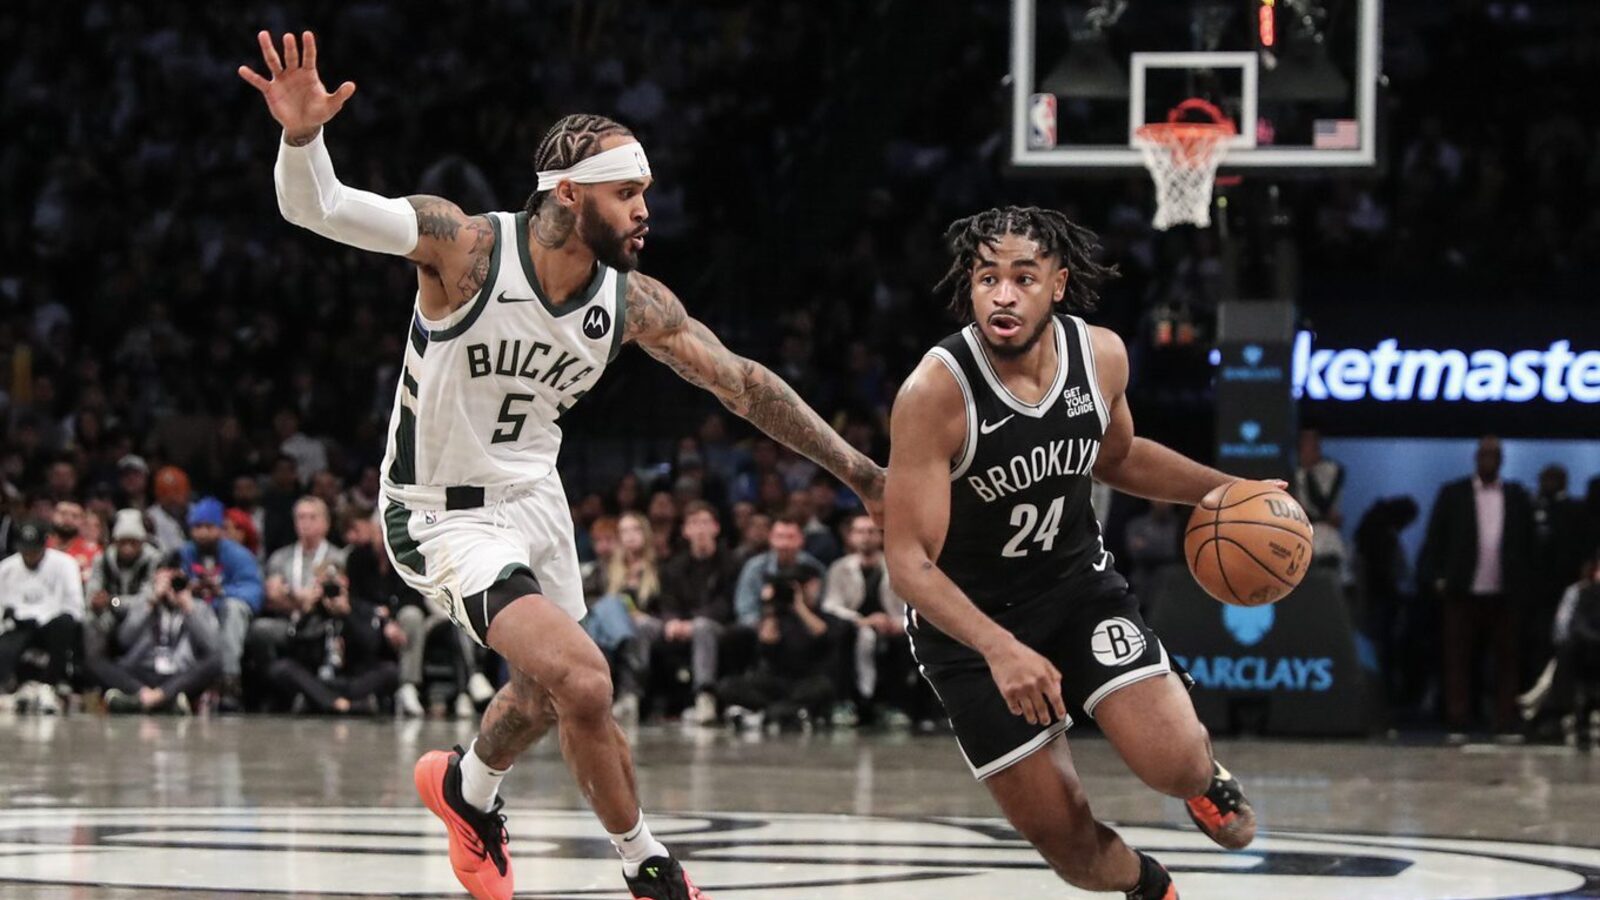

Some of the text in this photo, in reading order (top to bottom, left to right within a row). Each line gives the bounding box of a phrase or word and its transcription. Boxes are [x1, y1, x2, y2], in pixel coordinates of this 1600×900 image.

[467, 339, 594, 392] BUCKS
[1291, 330, 1600, 402] ketmaste
[1063, 386, 1080, 399] GET
[1065, 393, 1091, 409] YOUR
[1067, 401, 1094, 418] GUIDE
[491, 393, 535, 444] 5
[1001, 496, 1065, 558] 24
[1106, 624, 1132, 659] B
